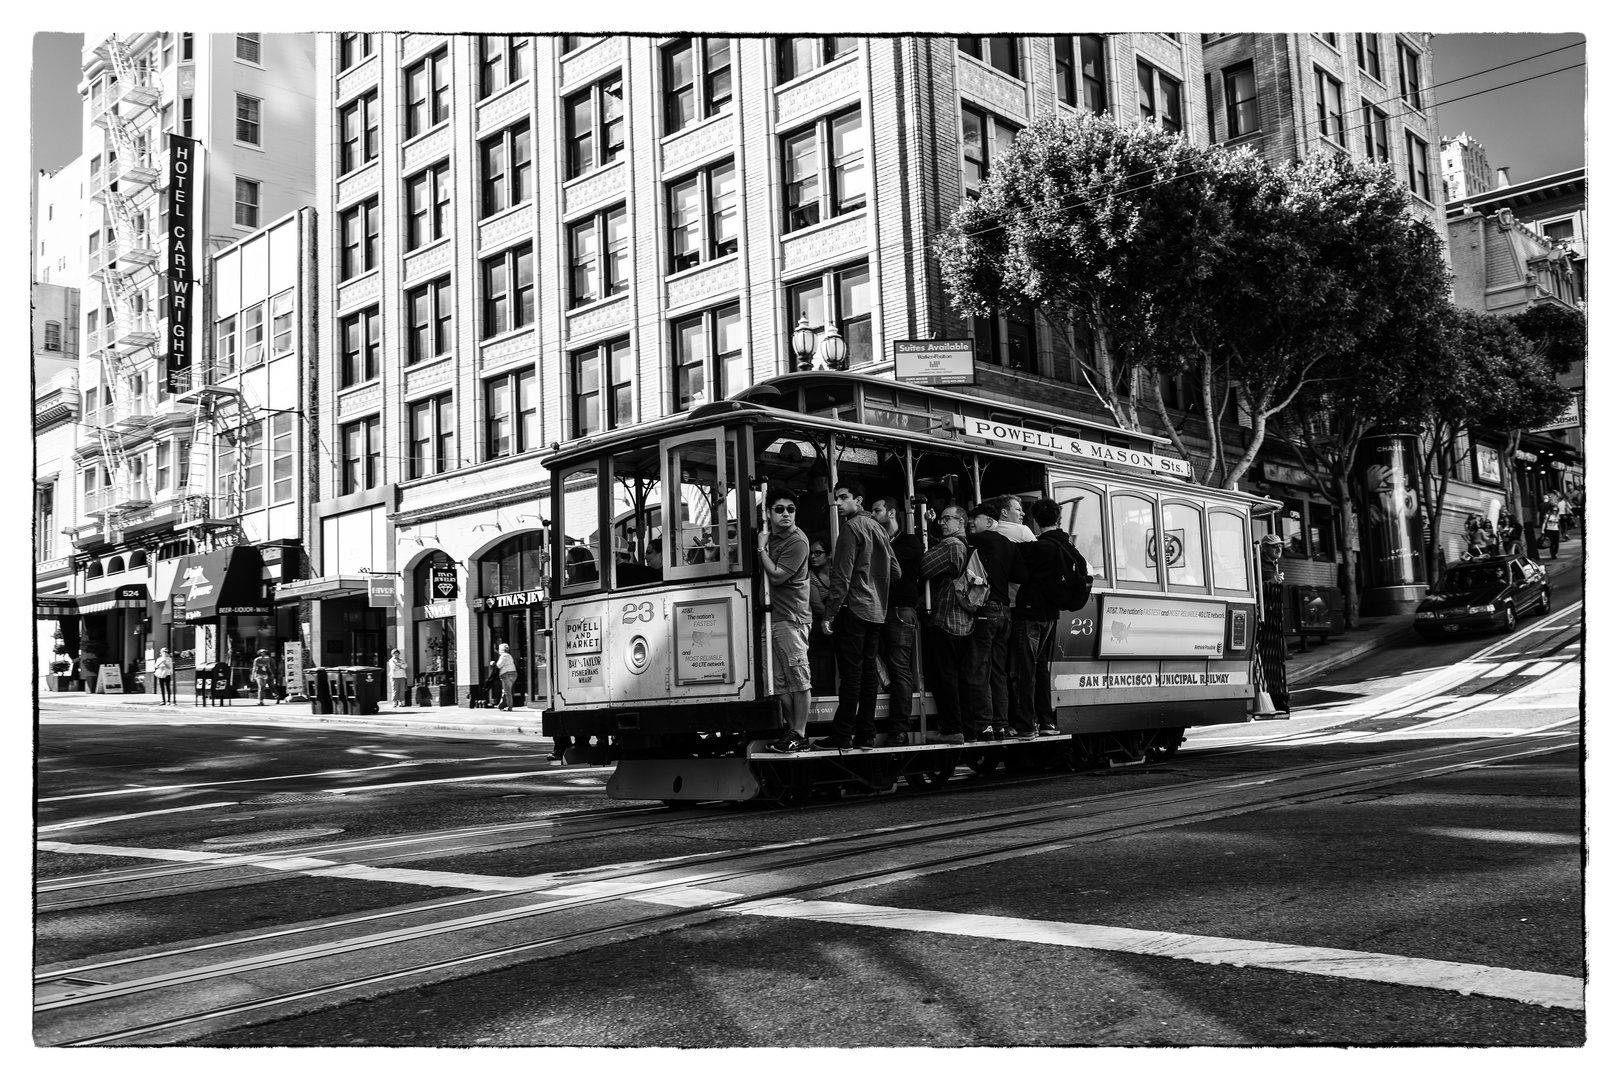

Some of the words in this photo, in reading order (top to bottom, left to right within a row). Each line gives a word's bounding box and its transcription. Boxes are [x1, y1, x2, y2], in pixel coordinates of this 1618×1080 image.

[175, 146, 189, 217] HOTEL
[173, 226, 189, 365] CARTWRIGHT
[899, 344, 925, 352] Suites
[928, 342, 969, 351] Available
[976, 421, 1063, 450] POWELL
[1070, 441, 1083, 454] &
[1091, 444, 1153, 467] MASON
[1160, 459, 1184, 473] Sts.
[496, 592, 526, 607] TINA'S
[622, 601, 655, 625] 23
[567, 622, 599, 633] POWELL
[1070, 618, 1094, 636] 23
[575, 631, 591, 640] AND
[566, 638, 599, 649] MARKET
[582, 656, 602, 668] TAYLOR
[1079, 676, 1099, 687] SAN
[1102, 674, 1152, 686] FRANCISCO
[1154, 673, 1198, 685] MUNICIPAL
[1199, 673, 1230, 684] RAILWAY
